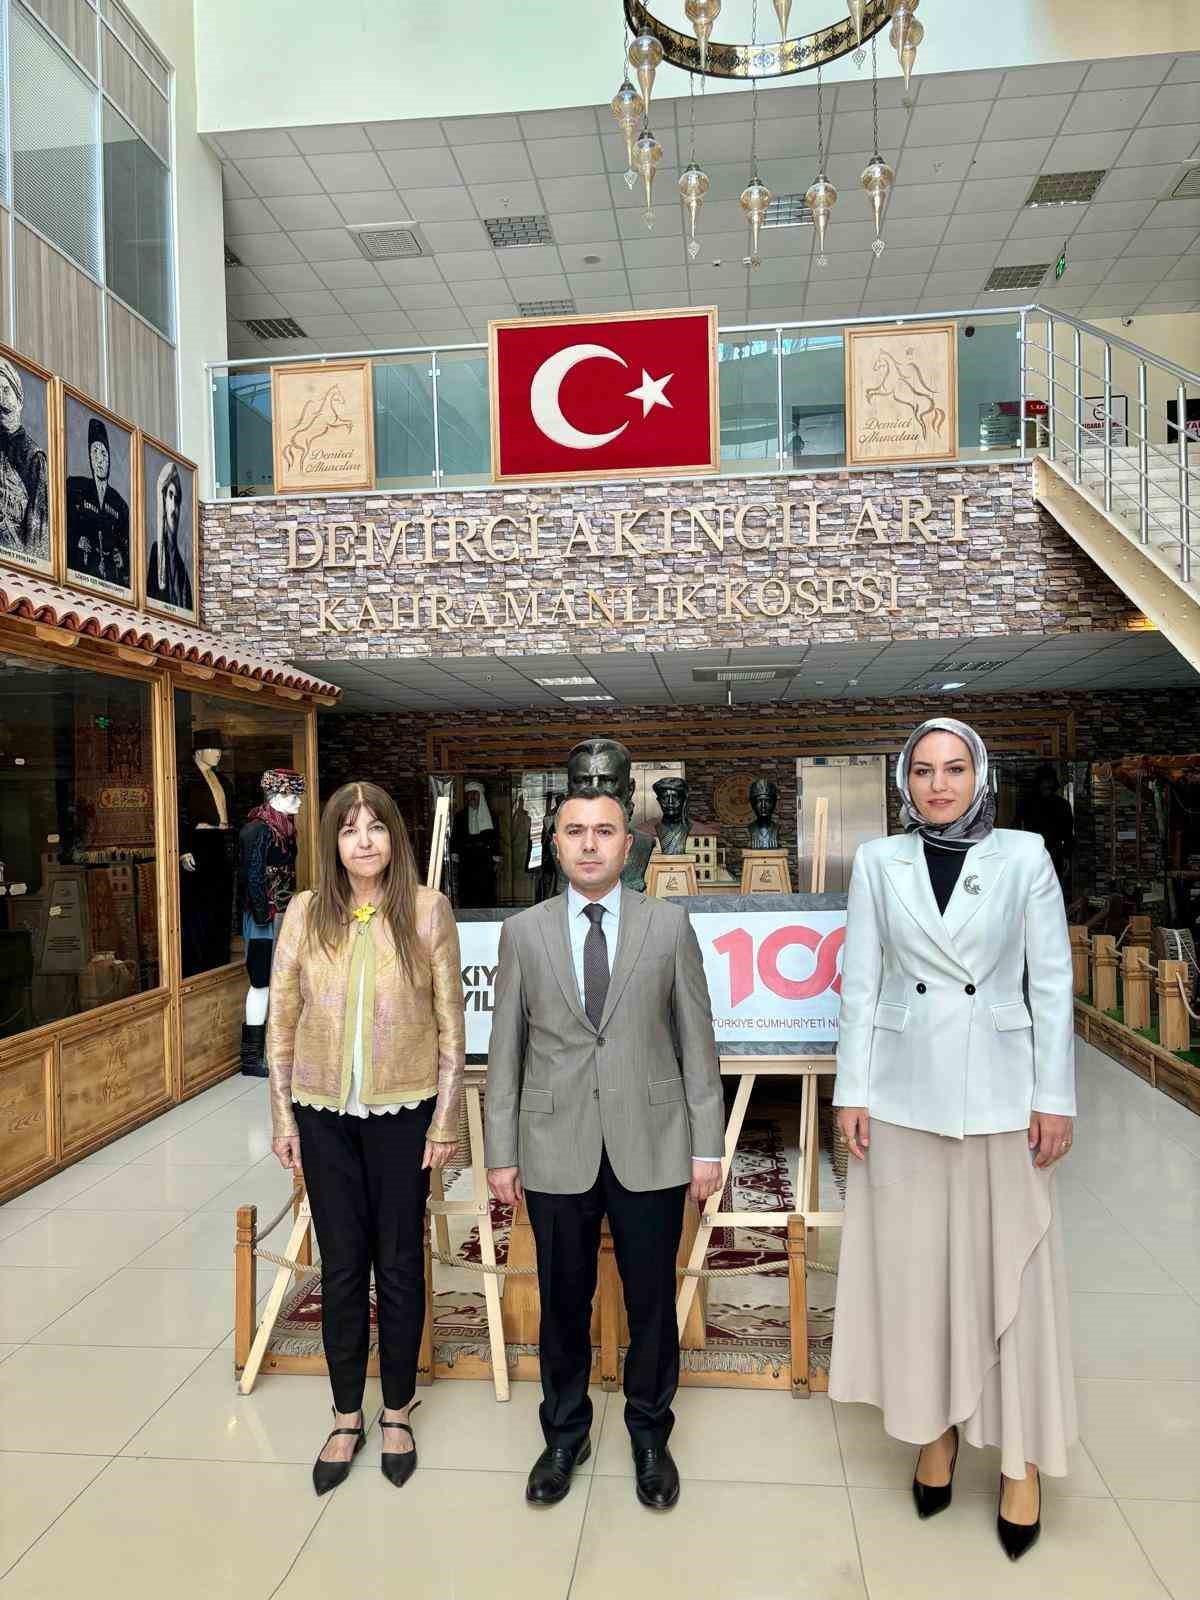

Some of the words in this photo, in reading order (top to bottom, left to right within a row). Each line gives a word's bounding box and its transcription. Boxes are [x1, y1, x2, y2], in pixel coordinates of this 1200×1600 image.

[279, 502, 545, 569] DEMİRCİ
[561, 494, 969, 559] AKINCILARI
[317, 584, 705, 632] KAHRAMANLIK
[723, 567, 904, 626] KÖŞESİ
